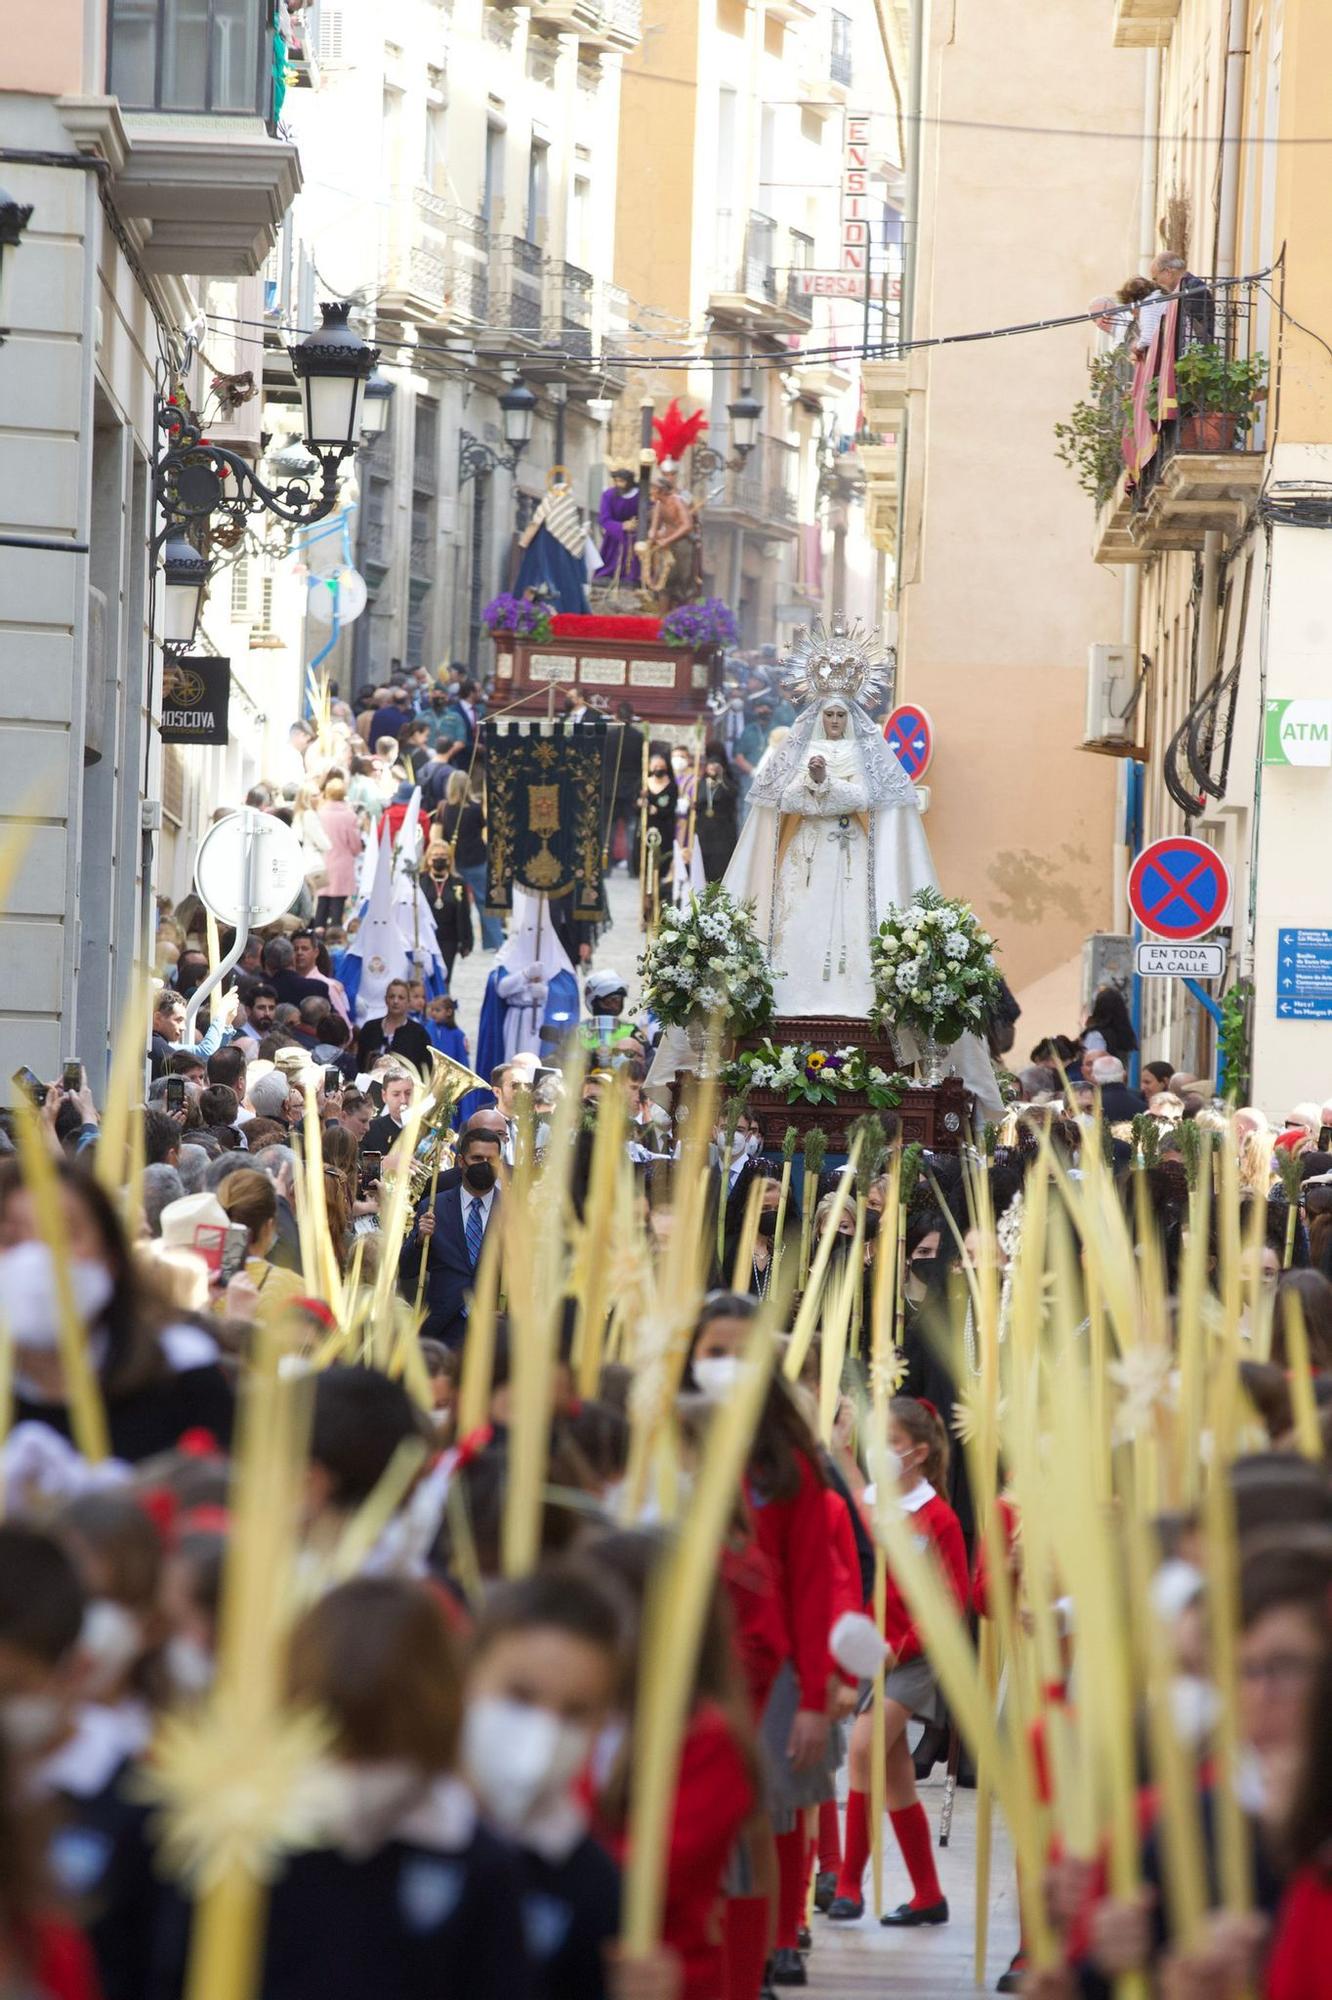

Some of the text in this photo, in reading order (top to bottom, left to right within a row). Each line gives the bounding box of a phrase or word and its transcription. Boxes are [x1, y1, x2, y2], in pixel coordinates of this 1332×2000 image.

[1282, 722, 1328, 741] ATM
[1150, 949, 1207, 960] EN TODA
[1148, 961, 1209, 972] LA CALLE
